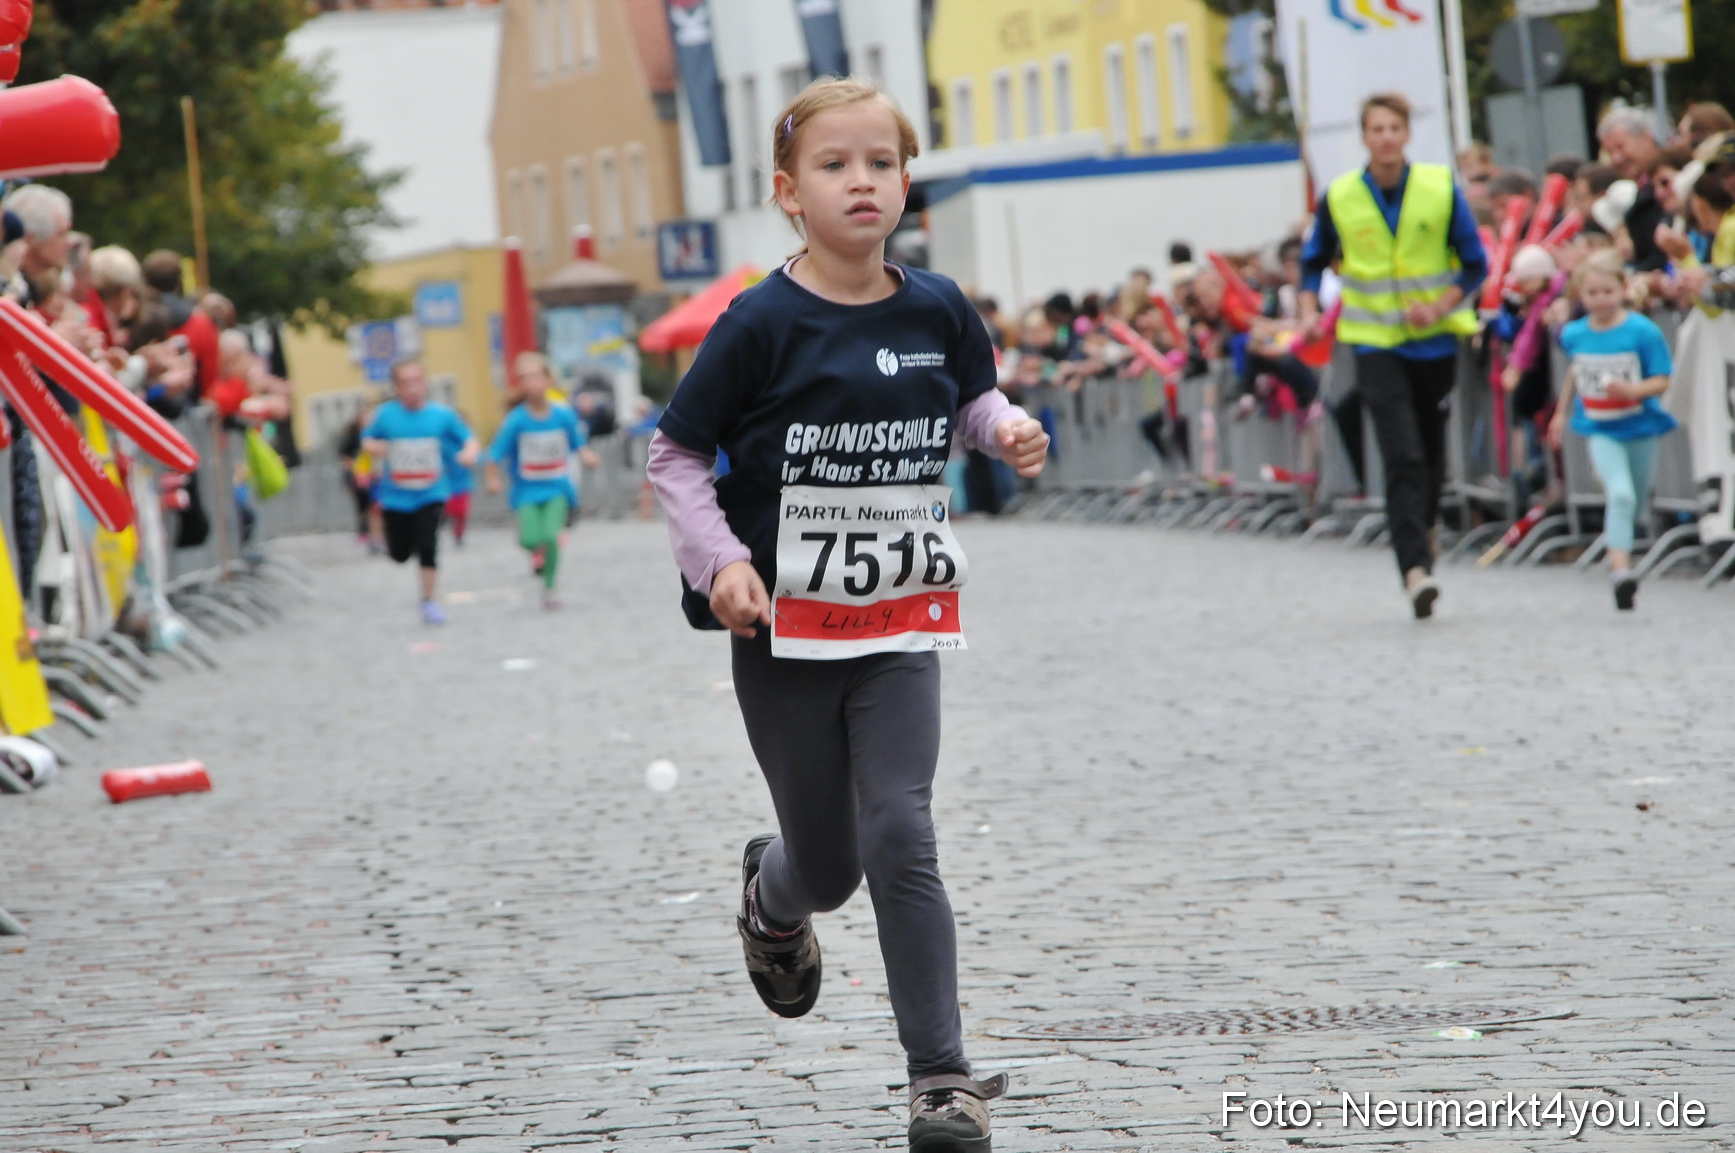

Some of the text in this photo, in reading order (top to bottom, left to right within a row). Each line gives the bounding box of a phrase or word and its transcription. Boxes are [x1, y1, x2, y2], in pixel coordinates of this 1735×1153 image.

[784, 417, 948, 455] GRUNDSCHULE
[810, 455, 863, 483] Haus
[785, 505, 928, 521] PARTL Neumarkt
[801, 532, 956, 596] 7516
[822, 607, 893, 633] LILLY
